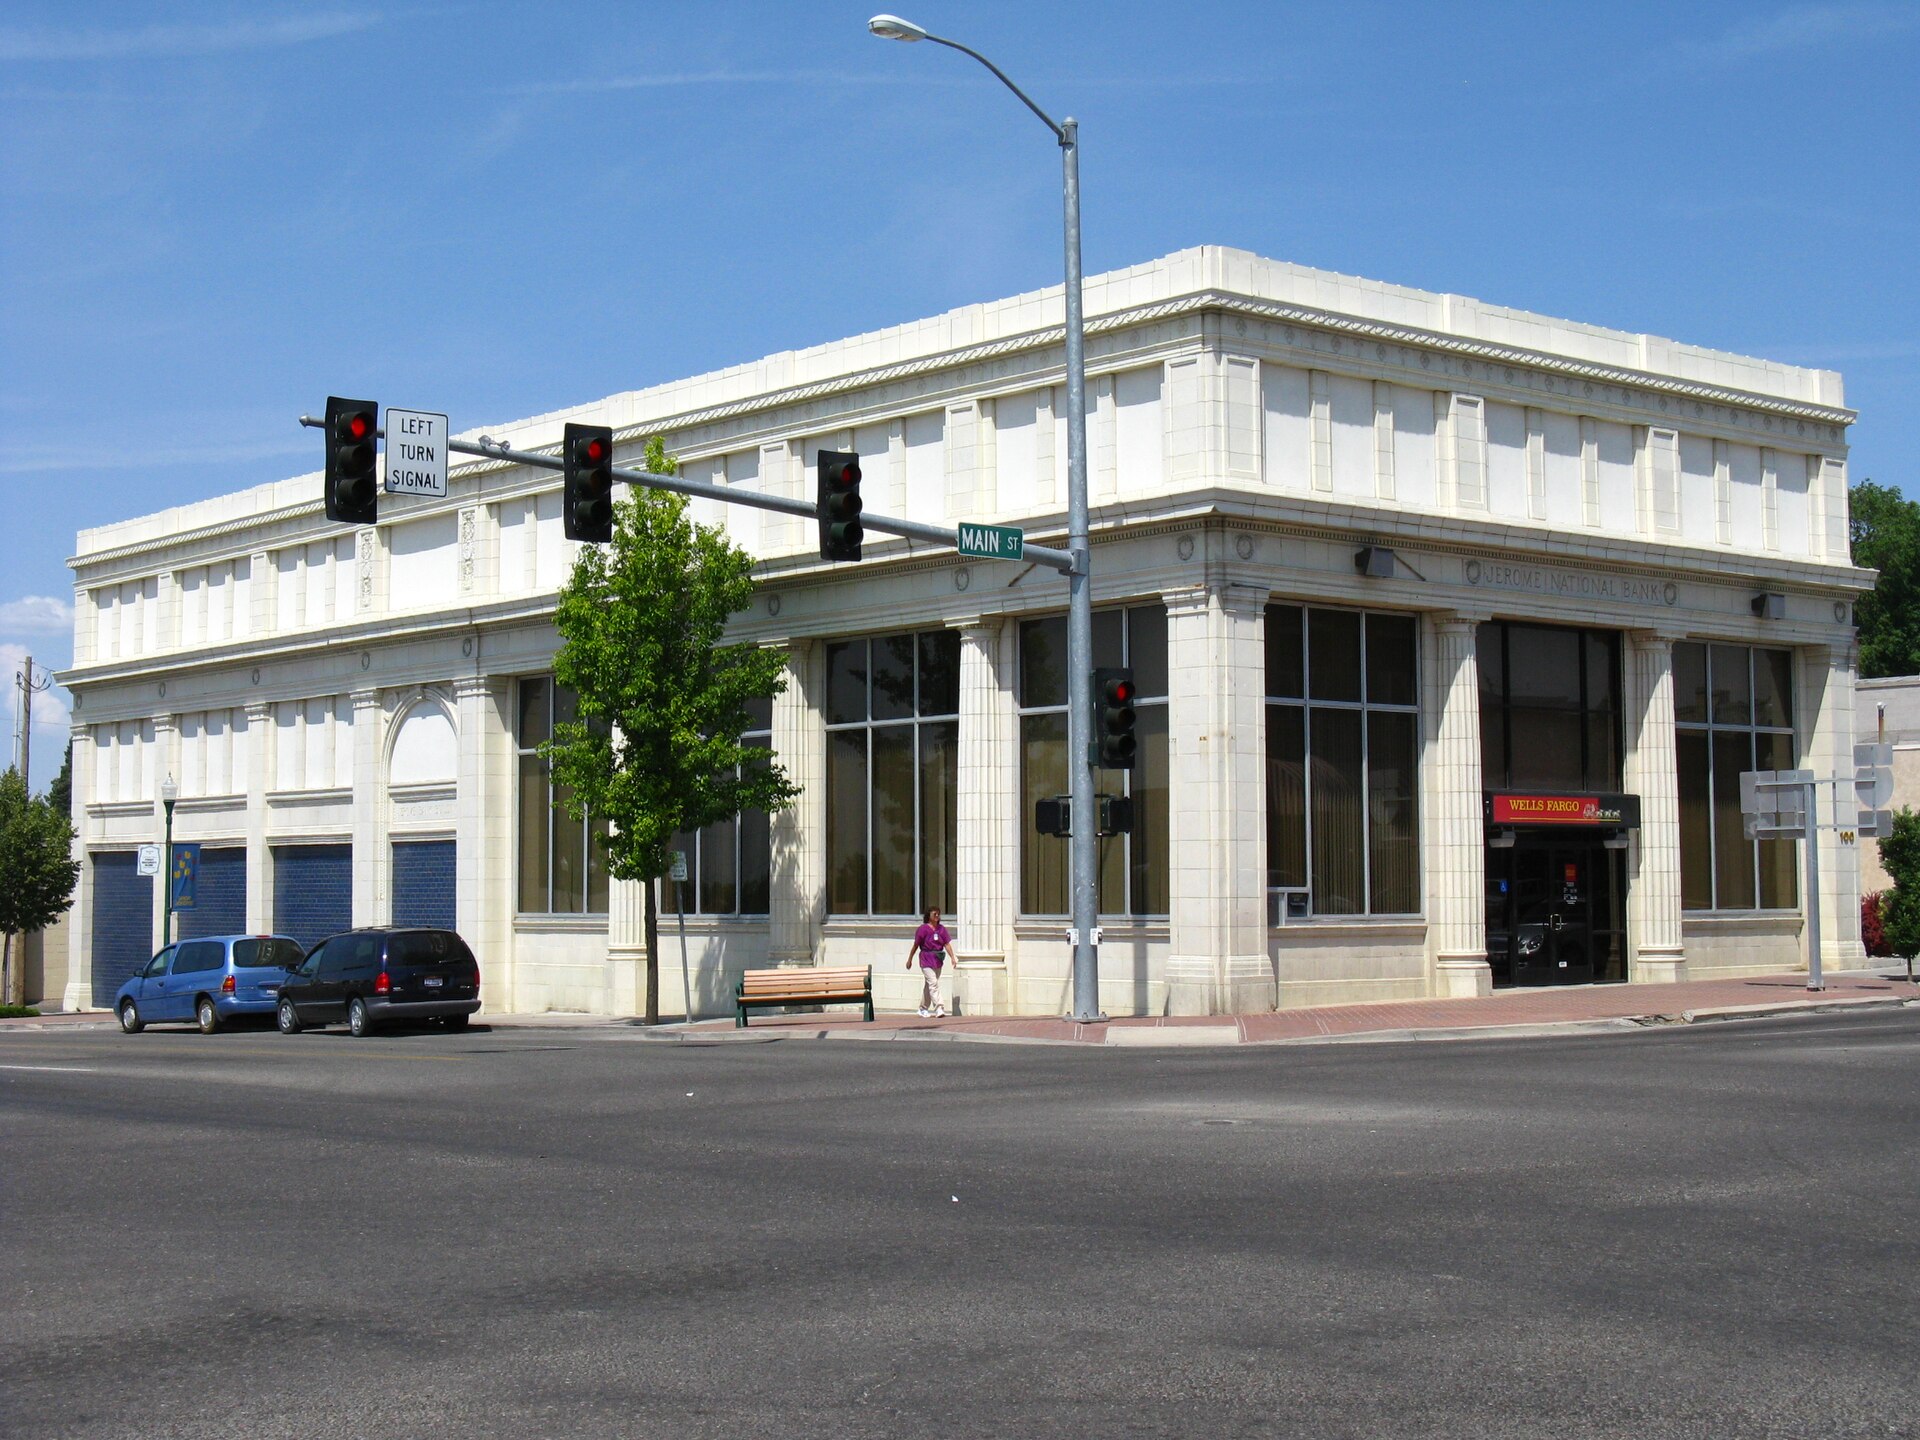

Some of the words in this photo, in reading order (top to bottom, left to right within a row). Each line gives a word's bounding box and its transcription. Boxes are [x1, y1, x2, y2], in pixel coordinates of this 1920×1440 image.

[401, 418, 433, 436] LEFT
[400, 444, 434, 462] TURN
[392, 469, 440, 489] SIGNAL
[962, 527, 999, 553] MAIN
[1007, 536, 1018, 551] ST
[1485, 566, 1541, 589] JEROME
[1550, 573, 1617, 597] NATIONAL
[1623, 581, 1658, 600] BANK
[1509, 799, 1544, 811] WELLS
[1546, 800, 1580, 812] FARGO
